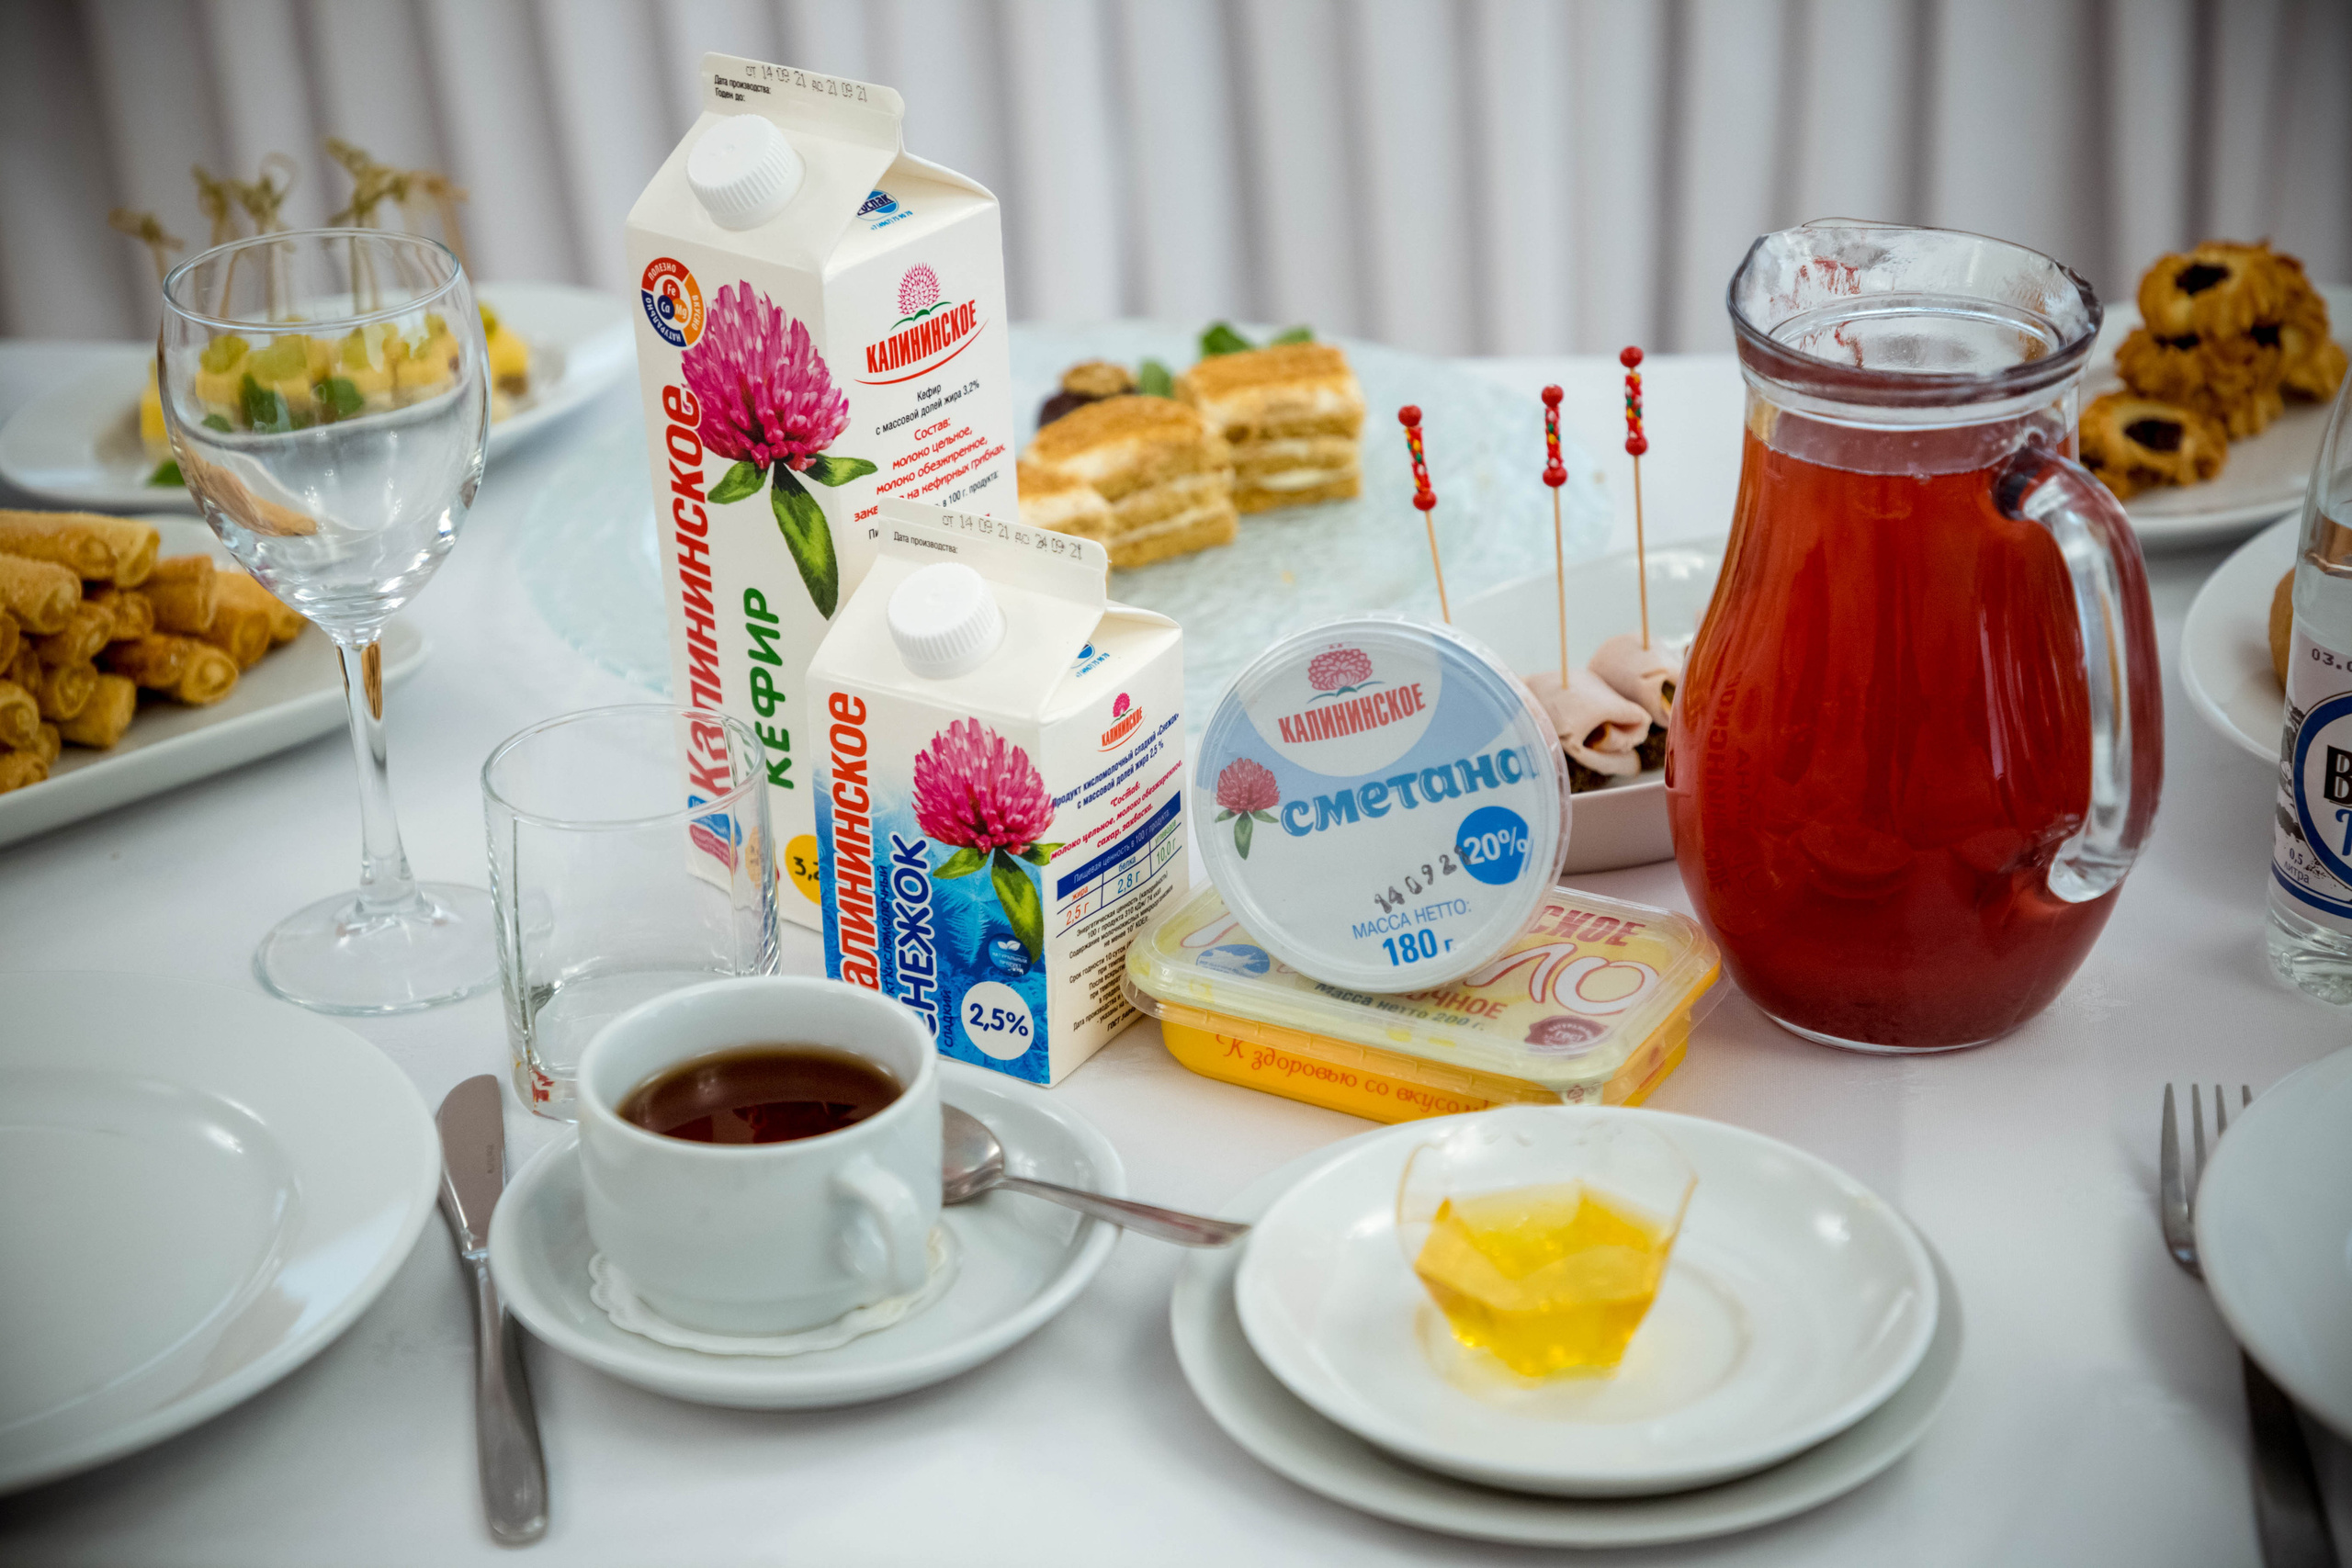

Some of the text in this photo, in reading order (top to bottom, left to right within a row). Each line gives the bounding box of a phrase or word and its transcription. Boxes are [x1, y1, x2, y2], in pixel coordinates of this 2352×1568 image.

[714, 74, 772, 96] Дата производства:
[715, 87, 746, 102] Годен до:
[793, 71, 807, 88] 21
[826, 79, 839, 97] 21
[855, 85, 869, 103] 21
[647, 262, 677, 281] ПОЛЕЗНО
[666, 283, 677, 296] Fe
[645, 297, 682, 343] НАТУРАЛЬНО
[661, 301, 672, 313] Ca
[674, 303, 688, 319] Mg
[691, 294, 702, 331] ВКУСНО
[865, 299, 978, 374] КАЛИНИНСКОЕ
[876, 378, 980, 436] с массовой долей жира 3,2%
[916, 384, 943, 402] Кефир
[892, 425, 974, 470] молоко цельное,
[913, 417, 952, 442] Состав:
[876, 417, 989, 496] молоко обезжиренное,
[907, 488, 921, 501] на
[921, 464, 970, 495] кефирных
[942, 499, 947, 508] в
[948, 490, 962, 504] 100
[968, 469, 1000, 495] продукта:
[893, 530, 910, 543] Дата
[910, 536, 959, 555] производства:
[997, 522, 1011, 541] 21
[662, 384, 733, 797] Калининское
[742, 586, 795, 790] КЕФИР
[1101, 705, 1143, 747] КАЛИНИНСКОЕ
[1277, 682, 1427, 744] КАЛИНИНСКОЕ
[1052, 784, 1082, 809] Продукт
[1083, 750, 1135, 792] кисломолочный
[1134, 730, 1157, 757] сладкий
[1077, 800, 1082, 810] с
[1082, 777, 1116, 807] массовой
[1115, 764, 1135, 788] долей
[1135, 756, 1150, 772] жира
[1049, 760, 1183, 861] молоко цельное, молоко обезжиренное,
[828, 691, 880, 991] алининское
[1096, 829, 1123, 849] сахар,
[1156, 839, 1172, 865] 10,0
[1462, 826, 1529, 866] 20%
[2289, 847, 2304, 865] 0,5
[1071, 886, 1089, 902] жира
[1118, 855, 1136, 873] белка
[1072, 861, 1103, 885] Пищевая
[1102, 844, 1131, 868] ценность
[1116, 870, 1141, 896] 2,8 г
[1066, 901, 1091, 927] 2,5 г
[1076, 908, 1116, 938] Энергетическая
[1115, 896, 1139, 914] ценность
[1087, 928, 1098, 940] 100
[1101, 913, 1125, 934] продукта
[1351, 897, 1473, 941] МАССА НЕТТО:
[1069, 937, 1101, 960] Содержание
[1102, 939, 1111, 949] не
[1382, 928, 1439, 967] 180
[1069, 944, 1127, 985] Срок годности 10 суток
[1096, 954, 1126, 977] при темпер
[1088, 978, 1104, 991] После
[1089, 974, 1122, 1001] при температ
[969, 1002, 1029, 1038] 2,5%
[1073, 1018, 1086, 1032] Дата
[1085, 996, 1118, 1022] производства
[1314, 982, 1374, 1007] Масса
[1376, 999, 1430, 1019] нетто
[1431, 1011, 1471, 1028] 200
[1216, 1032, 1246, 1061] К
[1250, 1047, 1359, 1089] здоровью
[1363, 1078, 1390, 1097] со
